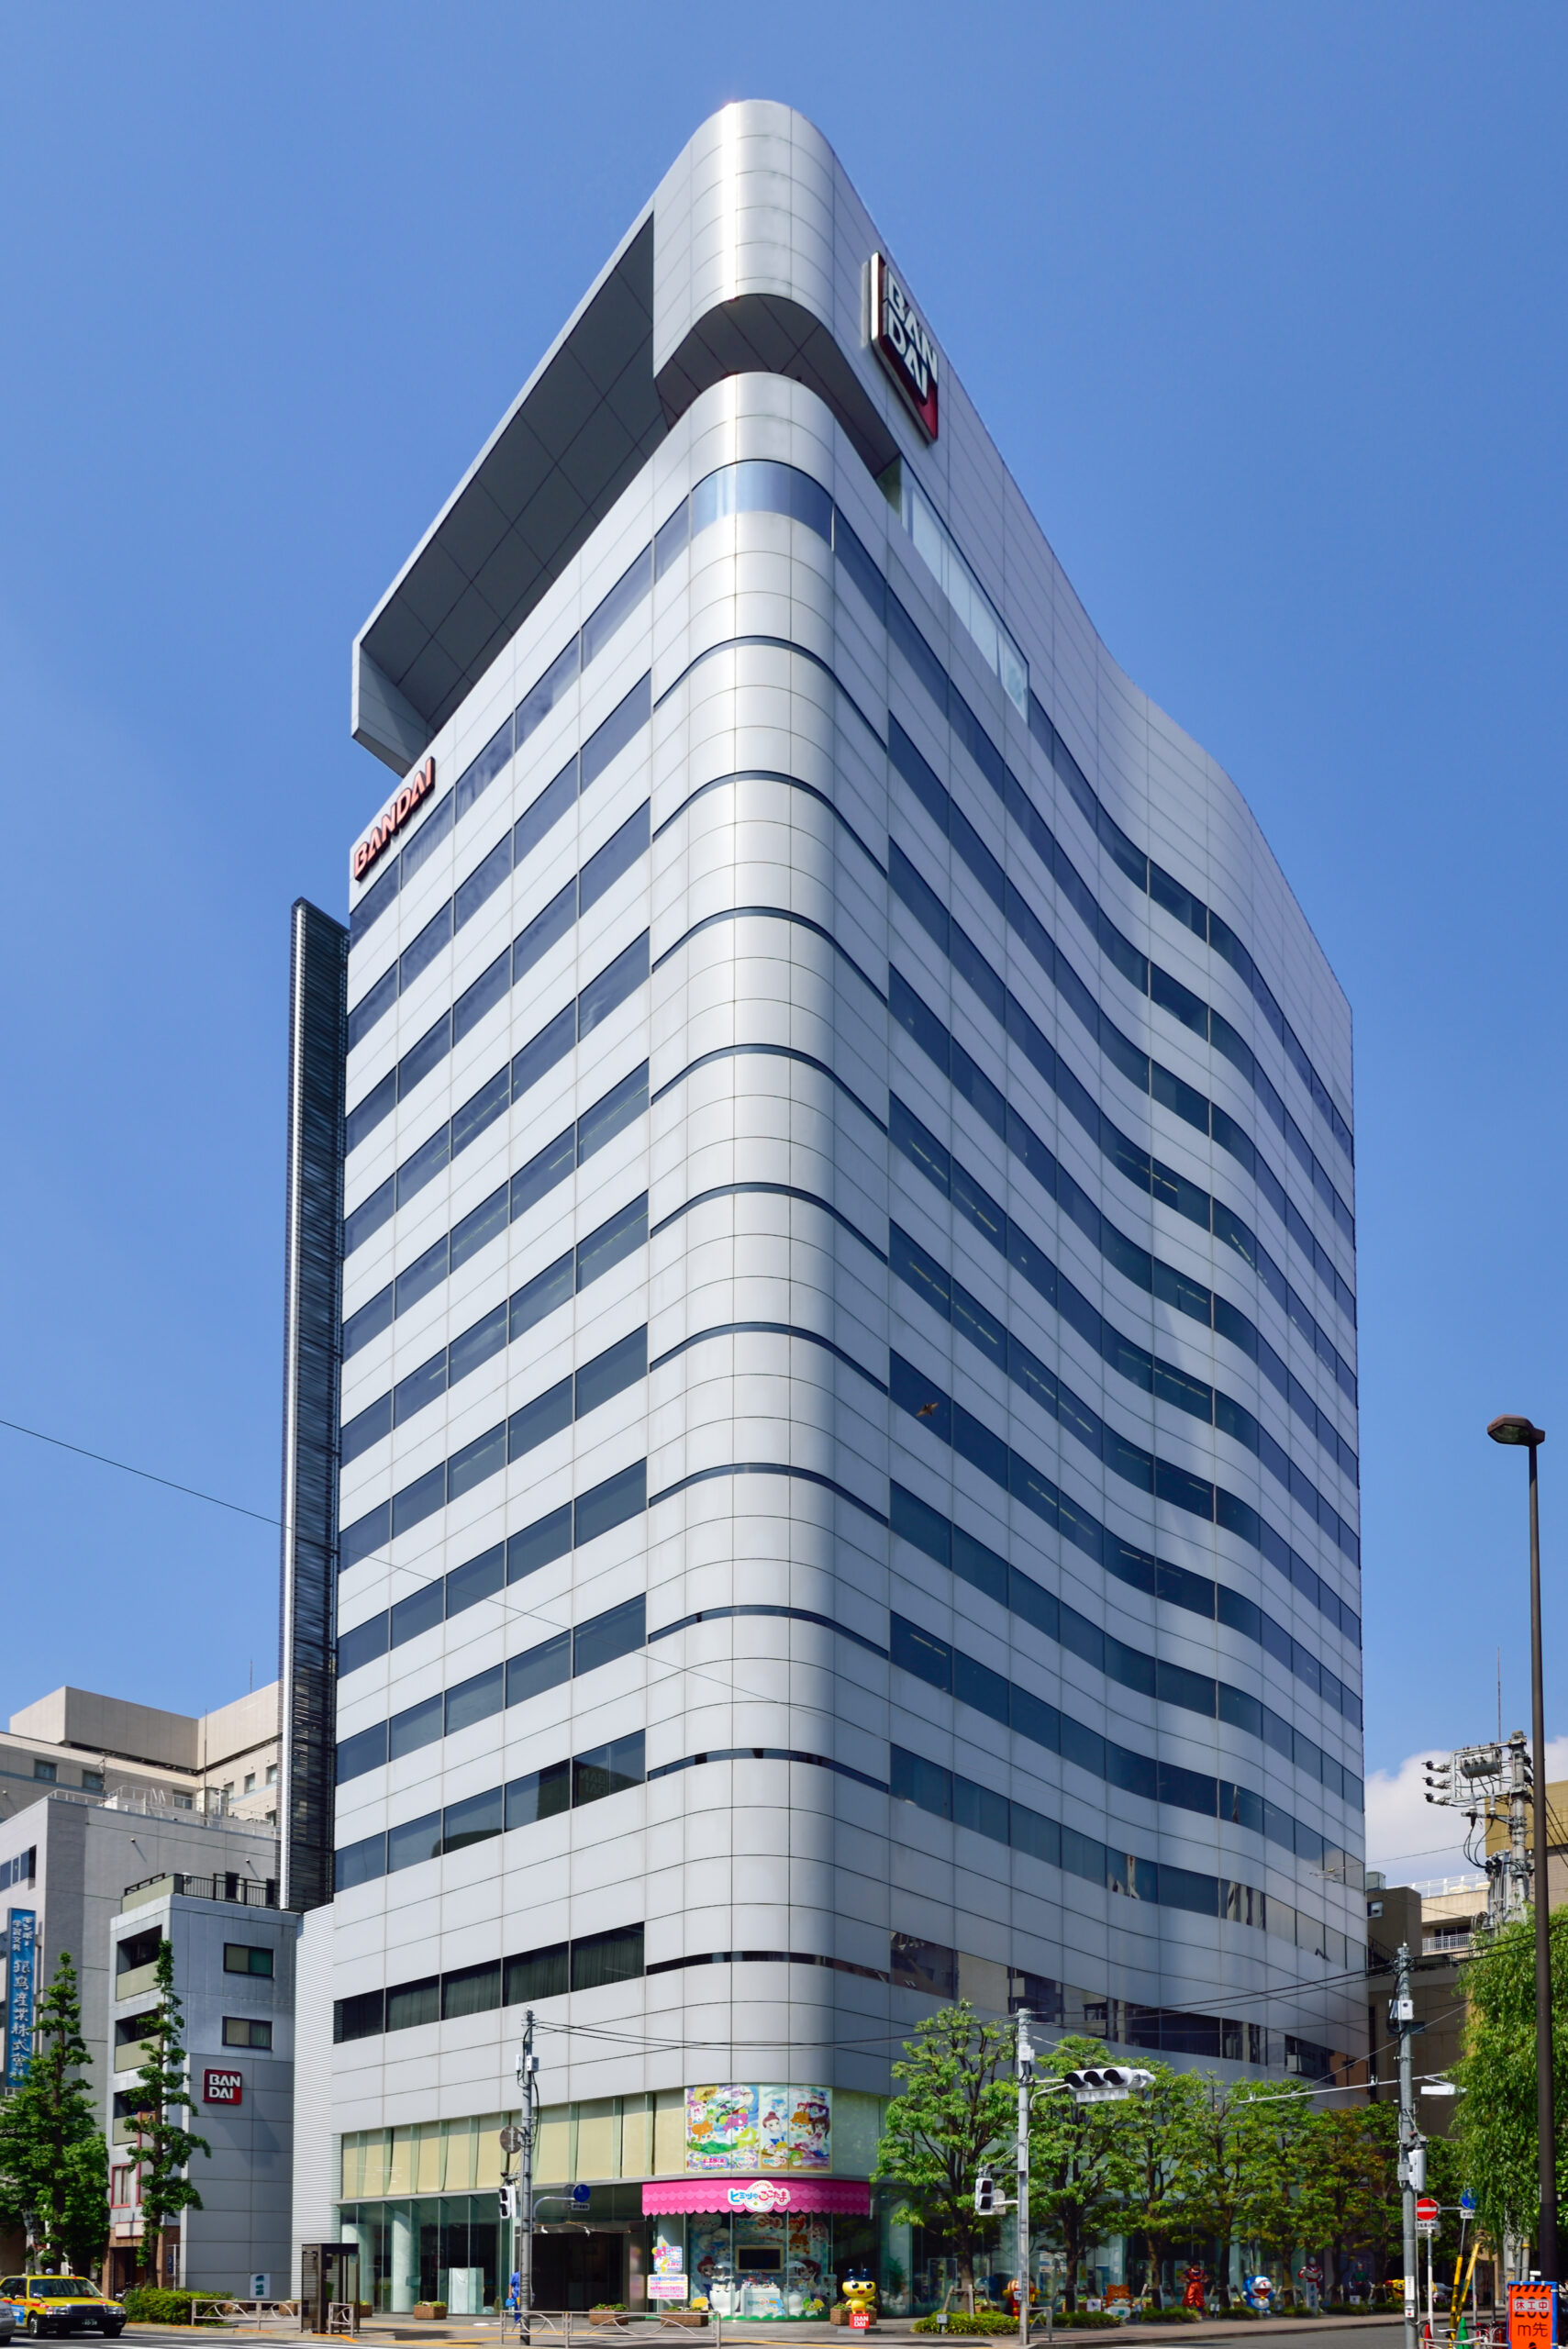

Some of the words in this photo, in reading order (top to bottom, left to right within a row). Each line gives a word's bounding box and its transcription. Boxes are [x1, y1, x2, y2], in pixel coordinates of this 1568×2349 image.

[884, 269, 938, 384] BAN
[884, 300, 928, 401] DAI
[354, 756, 434, 880] BANDAI
[208, 2074, 241, 2087] BAN
[208, 2086, 234, 2099] DAI
[730, 2189, 788, 2203] ヒミツのここたま
[1516, 2301, 1548, 2310] 休工中
[1518, 2321, 1549, 2338] m先
